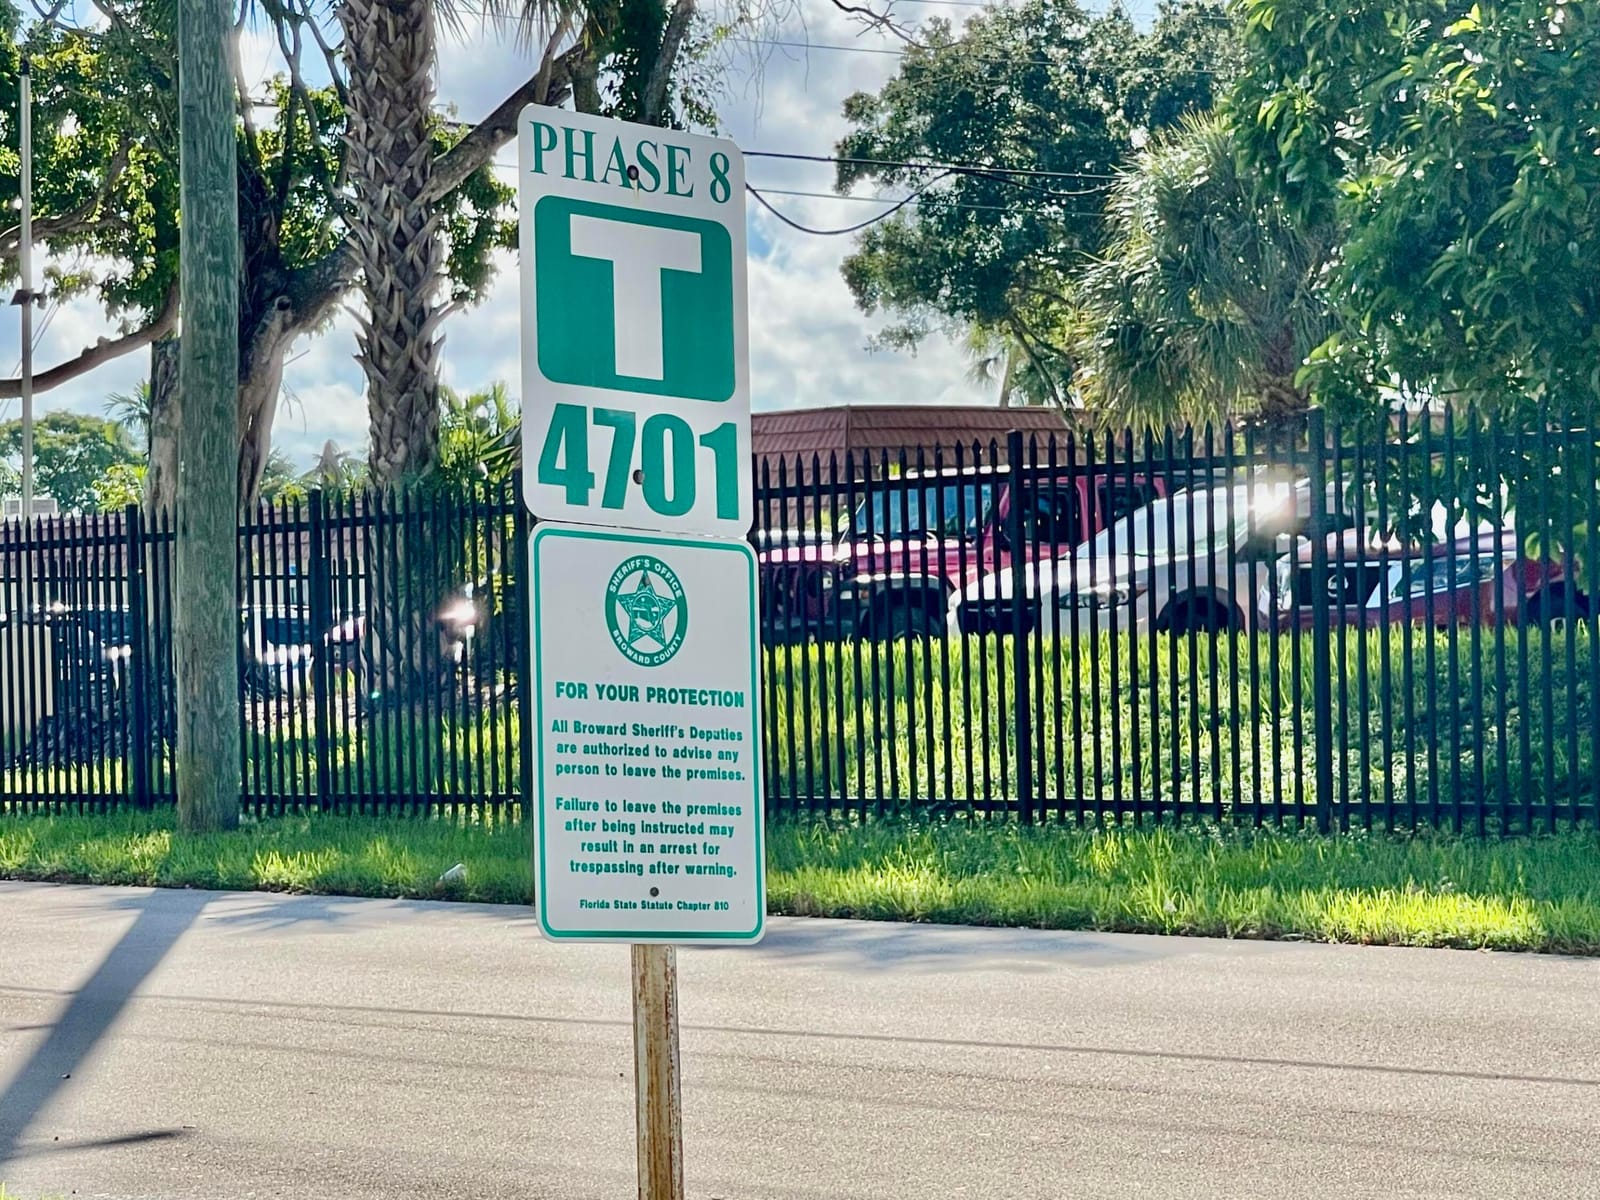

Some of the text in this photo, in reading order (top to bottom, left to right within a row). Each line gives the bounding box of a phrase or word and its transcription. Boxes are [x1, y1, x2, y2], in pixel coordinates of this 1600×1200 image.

[530, 121, 731, 203] PHASE 8
[570, 213, 702, 380] T
[538, 403, 739, 520] 4701
[609, 559, 682, 598] SHERIFF'S OFFICE
[613, 630, 680, 664] BROWARD COUNTY
[556, 682, 744, 707] FOR YOUR PROTECTION
[552, 720, 743, 742] All Broward Sheriff's Deputies
[556, 743, 739, 763] are authorized to advise any
[556, 764, 745, 781] person to leave the premises.
[556, 797, 742, 817] Failure to leave the premises
[565, 818, 734, 838] after being instructed may
[581, 840, 720, 855] result in an arrest for
[570, 860, 737, 878] trespassing after warning.
[580, 899, 729, 911] Florida State Statute Chapter 810
